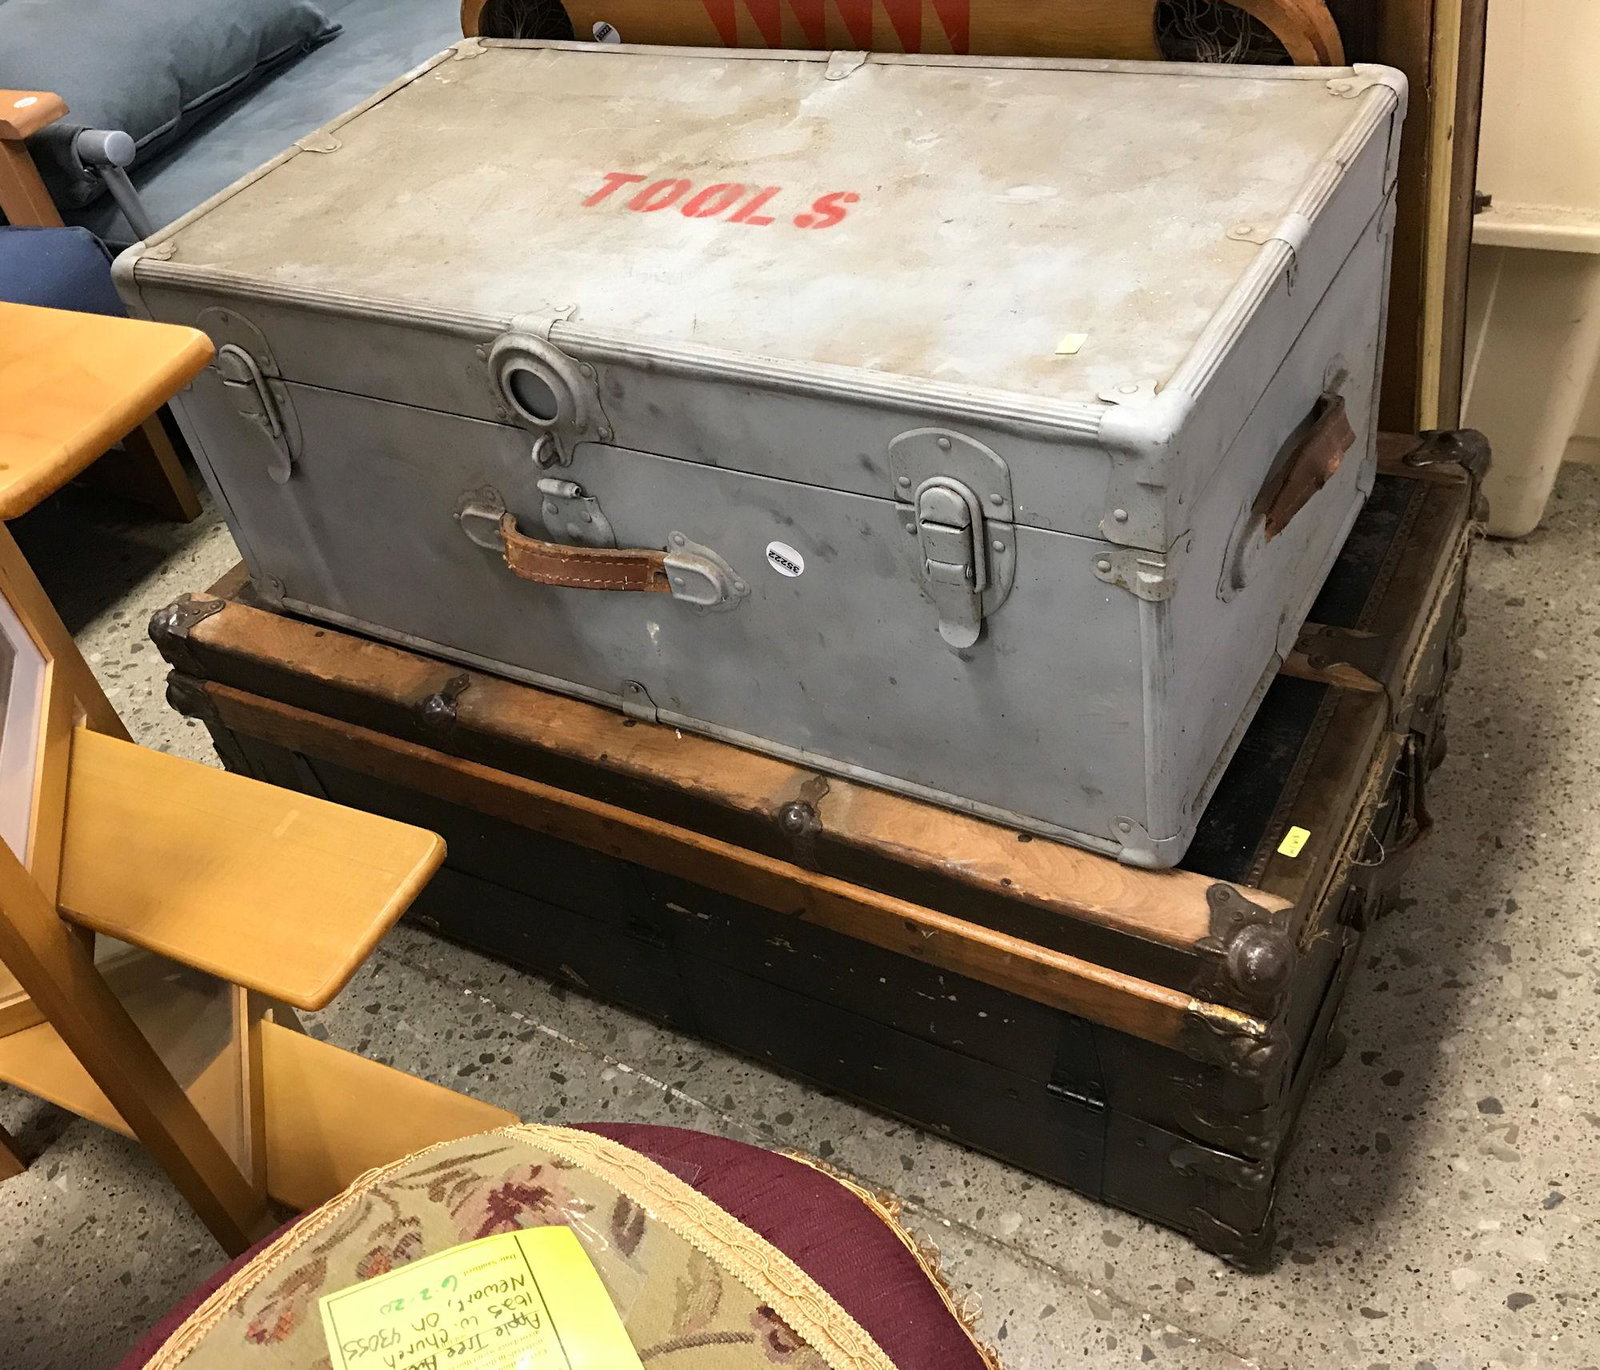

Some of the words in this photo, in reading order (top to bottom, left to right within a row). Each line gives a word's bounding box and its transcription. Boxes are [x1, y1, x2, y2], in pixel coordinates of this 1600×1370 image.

[580, 171, 860, 229] TOOLS
[768, 550, 799, 574] 35222
[496, 1312, 541, 1337] Apple
[342, 1327, 401, 1361] 43055
[447, 1333, 489, 1358] Tree
